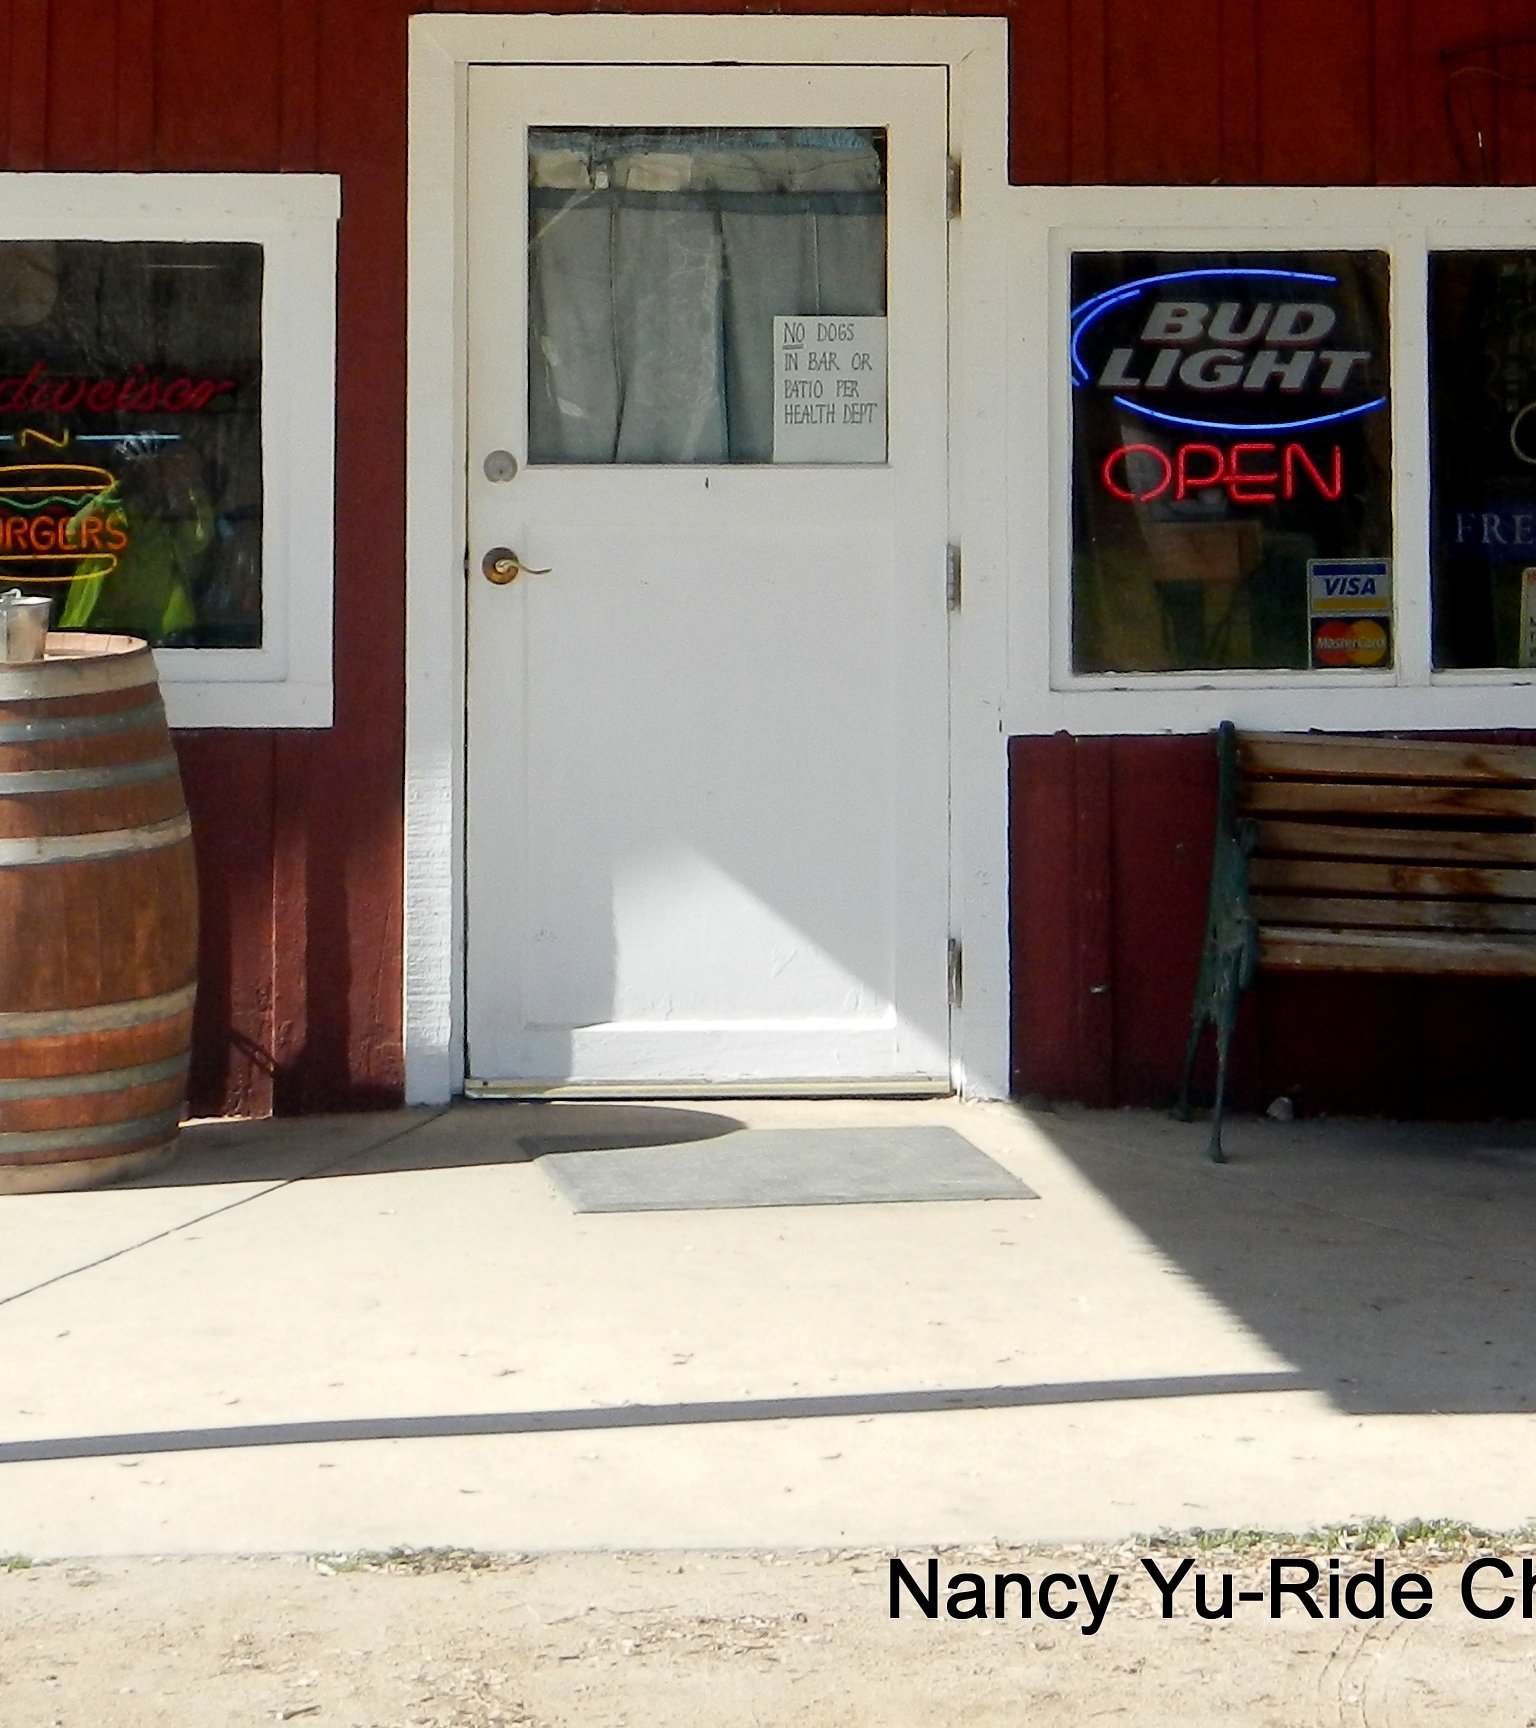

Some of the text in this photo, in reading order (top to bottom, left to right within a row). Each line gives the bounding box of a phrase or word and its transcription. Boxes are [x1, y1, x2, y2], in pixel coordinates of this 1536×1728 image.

[783, 322, 855, 343] NO DOGS
[1140, 301, 1337, 347] BUD
[784, 351, 873, 371] IN BAR OR
[1097, 347, 1372, 394] LIGHT
[784, 379, 860, 398] PATIO PER
[784, 403, 878, 424] HEALTH DEPT
[1101, 442, 1345, 503] OPEN
[1325, 577, 1376, 596] VISA
